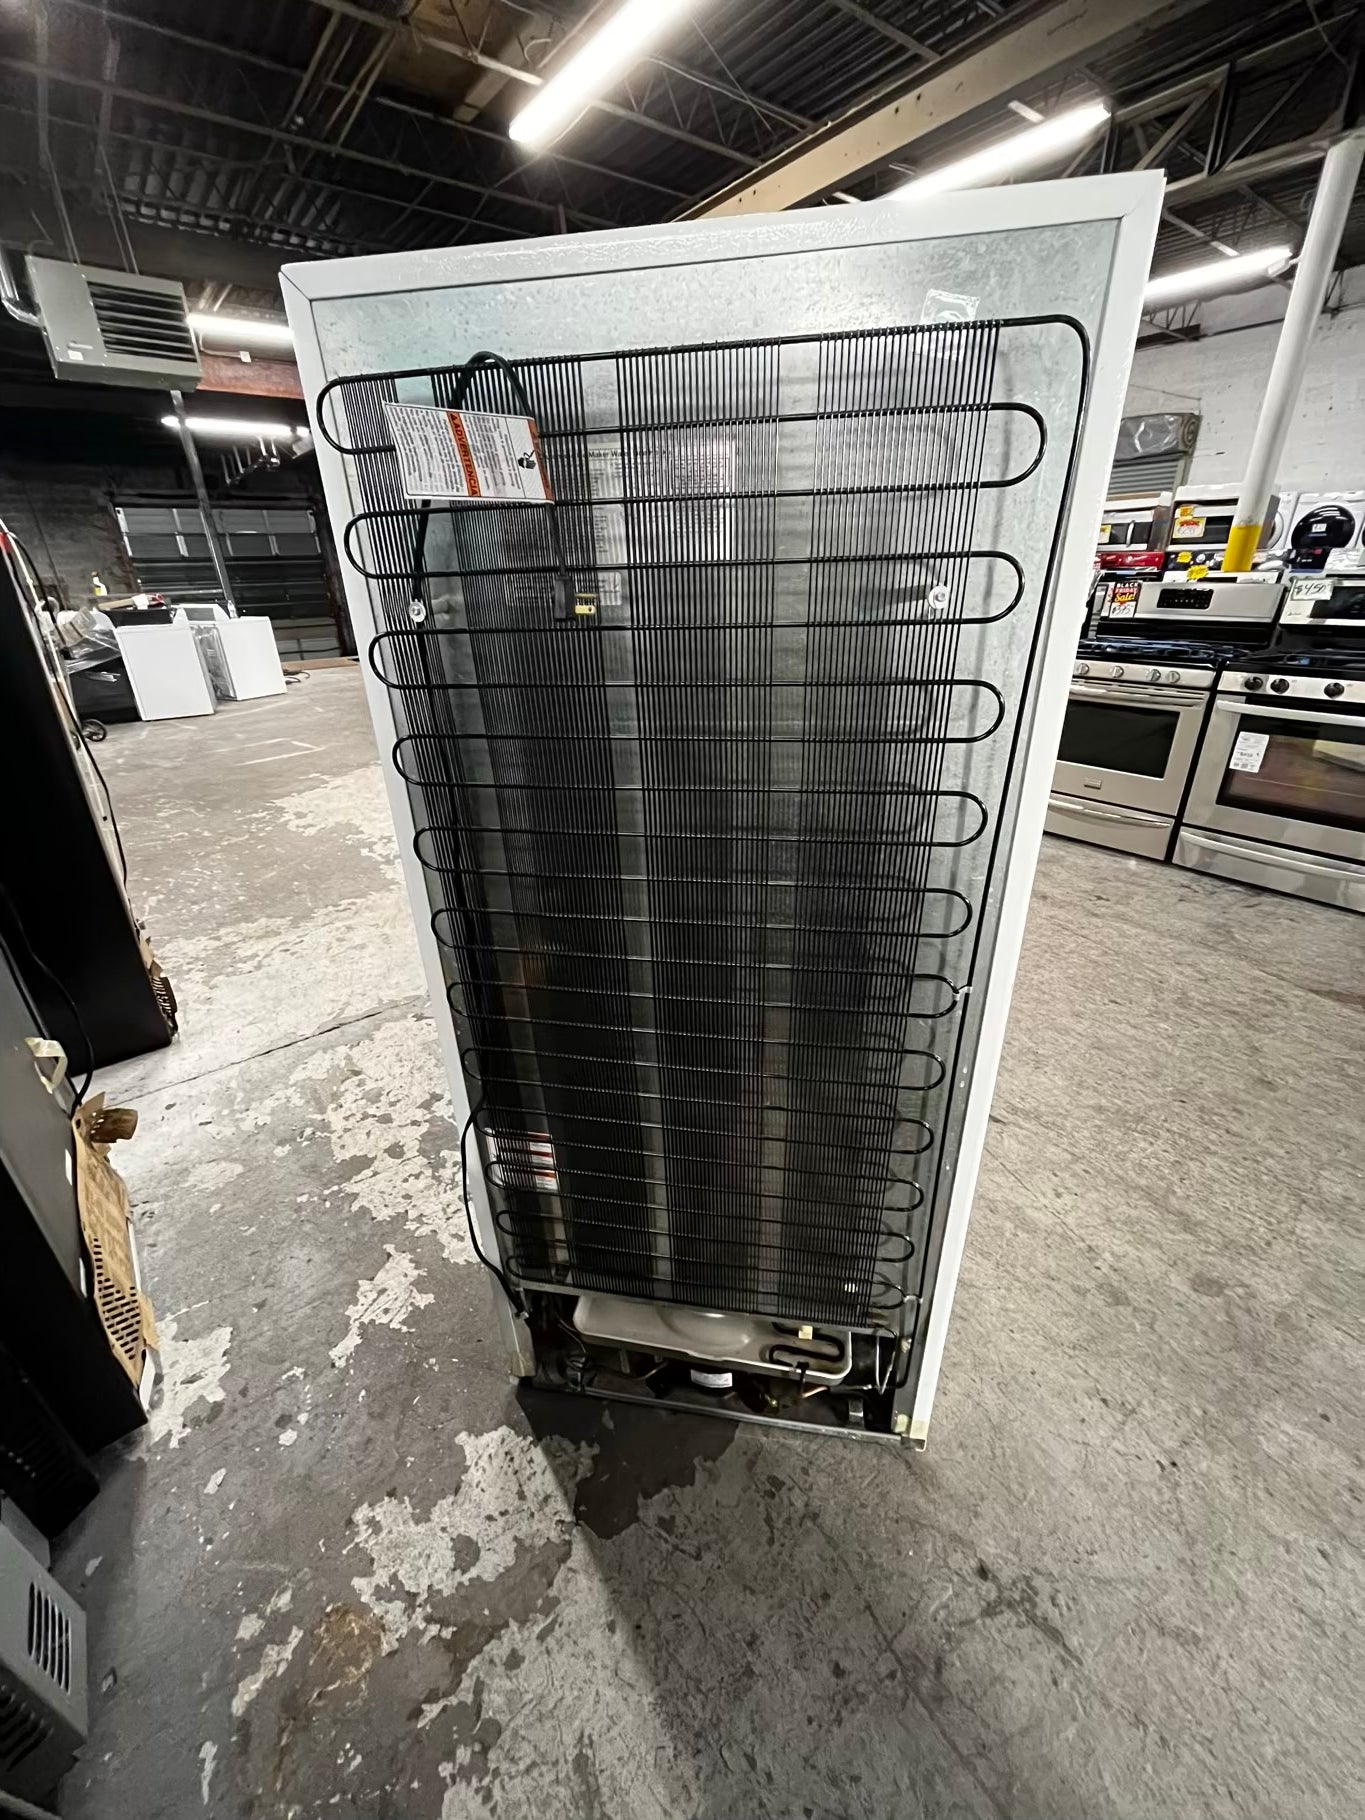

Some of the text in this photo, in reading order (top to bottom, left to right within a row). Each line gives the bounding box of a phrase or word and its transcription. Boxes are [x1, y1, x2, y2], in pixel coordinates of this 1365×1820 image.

[453, 422, 478, 496] ADVERTENCIA
[588, 450, 609, 459] Maker
[1114, 592, 1136, 602] Sale!
